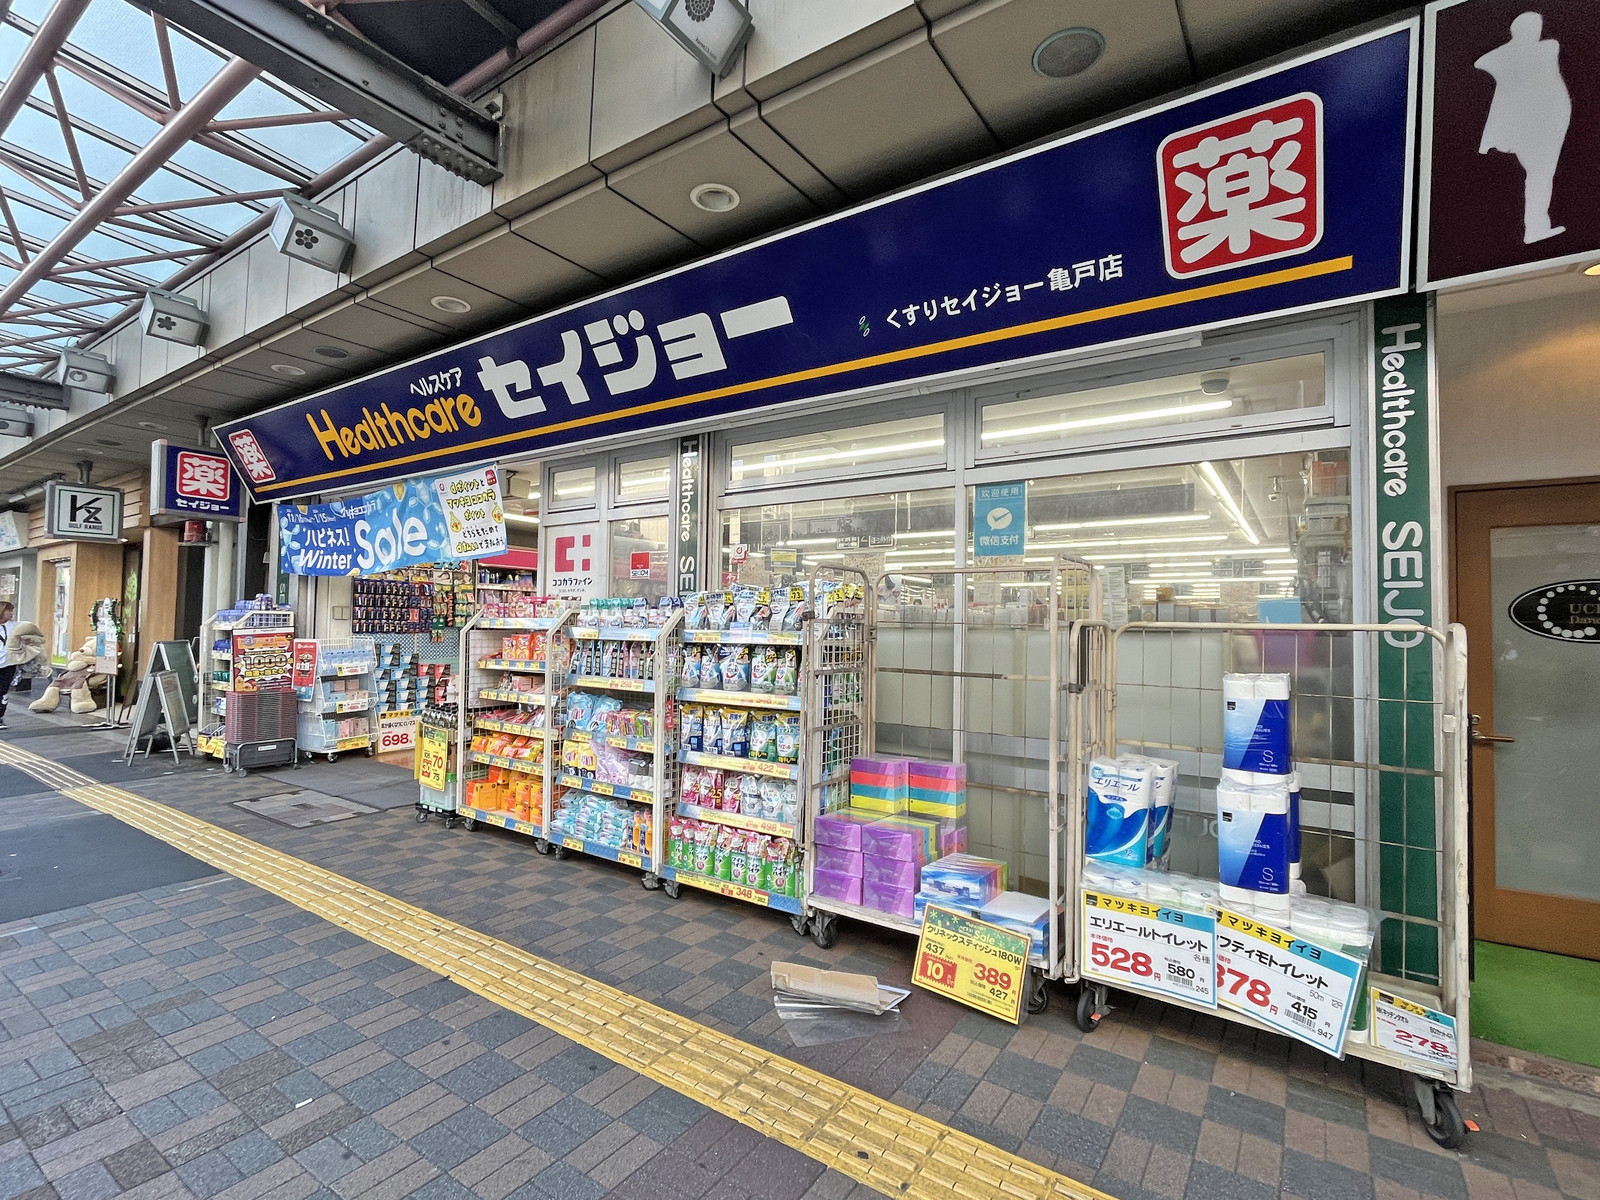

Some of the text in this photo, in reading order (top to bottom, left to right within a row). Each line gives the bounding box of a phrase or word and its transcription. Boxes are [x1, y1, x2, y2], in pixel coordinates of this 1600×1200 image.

[1172, 118, 1306, 264] 薬
[885, 254, 1124, 330] くすりセイジョー亀戸店
[477, 295, 794, 420] セイジョー
[409, 366, 463, 398] ヘルスケア
[305, 393, 483, 461] Healthcare
[233, 434, 272, 481] 薬
[182, 457, 225, 496] 薬
[682, 441, 698, 542] Healthcare
[981, 486, 1019, 498] 欢迎使用
[1381, 322, 1426, 649] Healthcare SEIJO
[176, 498, 230, 511] セイジョー
[299, 508, 428, 570] Winter Sale
[304, 527, 350, 548] ハピネス!
[979, 534, 1019, 546] 微信支付
[552, 577, 593, 587] ココカラファイン
[382, 733, 409, 747] 698
[432, 755, 443, 769] 70
[1263, 750, 1274, 763] S
[433, 773, 440, 781] 75
[1094, 777, 1140, 792] エリエール
[761, 822, 777, 831] 498
[1262, 867, 1274, 881] S
[736, 887, 752, 898] 348
[1102, 897, 1184, 923] マツキヨイイヨ
[974, 929, 995, 945] Sale
[1090, 916, 1208, 952] エリエールトイレット
[1228, 915, 1323, 960] マツキヨイイヨ
[925, 942, 945, 956] 437
[1091, 942, 1162, 982] 528 円
[1193, 954, 1211, 965] 各種
[1216, 934, 1329, 989] フティモトイレット
[927, 960, 944, 980] 10
[974, 962, 1012, 991] 389
[1167, 963, 1195, 979] 580
[989, 987, 1009, 1000] 427
[1195, 985, 1209, 995] 245
[1309, 989, 1325, 1002] 50m
[1269, 1004, 1279, 1015] 円
[1291, 1002, 1318, 1020] 415
[1317, 1028, 1334, 1040] 947
[1395, 1029, 1450, 1054] 278
